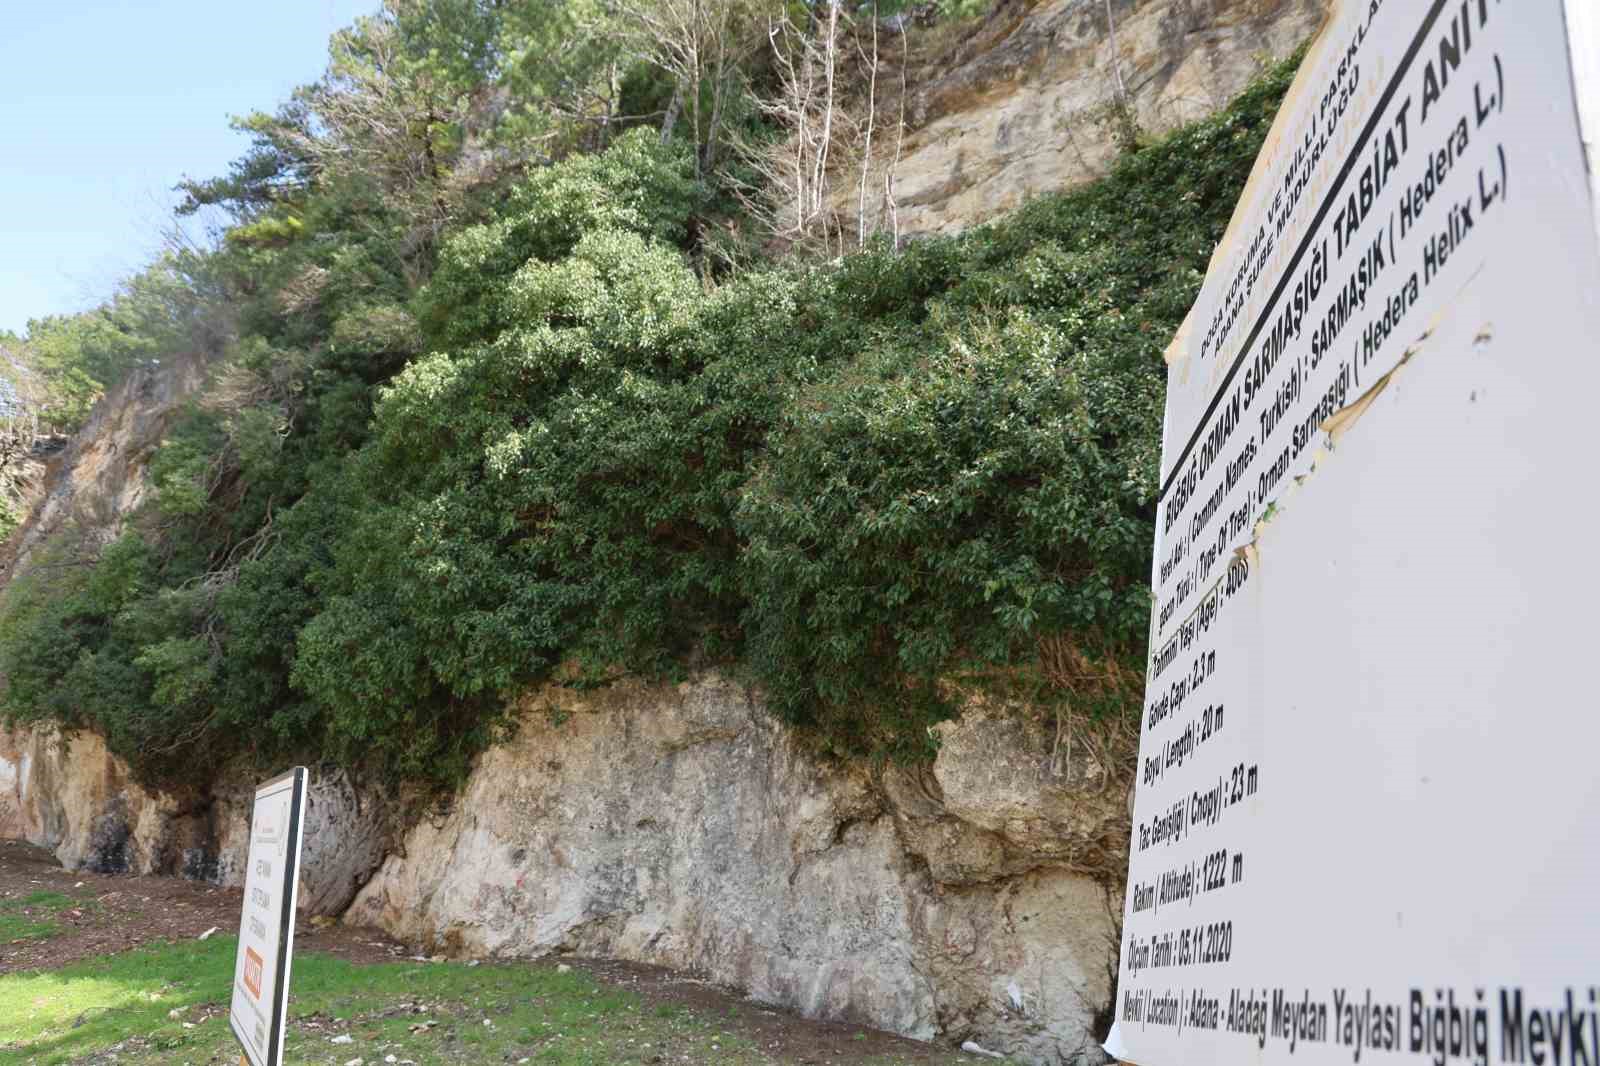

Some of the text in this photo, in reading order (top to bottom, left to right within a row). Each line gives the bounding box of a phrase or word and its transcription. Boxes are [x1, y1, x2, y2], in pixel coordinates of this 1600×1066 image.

[1268, 189, 1281, 224] VE
[1321, 0, 1384, 121] PARKLA
[1192, 480, 1224, 542] Common
[1311, 228, 1385, 371] SARMAŞIK
[1399, 115, 1469, 240] Hedera
[1200, 385, 1241, 480] ORMAN
[1243, 239, 1328, 410] SARMAŞIĞI
[1333, 94, 1411, 260] TABİAT
[1214, 293, 1244, 358] ADANA
[1246, 231, 1274, 297] ŞUBE
[1200, 543, 1217, 583] Type
[1218, 520, 1228, 556] Of
[1258, 446, 1290, 505] Orman
[1363, 272, 1419, 367] Hedera
[1424, 196, 1474, 286] Helix
[1207, 649, 1216, 678] m
[1143, 754, 1161, 788] Boyu
[1201, 704, 1213, 742] 20
[1215, 703, 1224, 733] m
[1138, 823, 1151, 852] Tac
[1230, 762, 1244, 805] 23
[1247, 764, 1258, 796] m
[1132, 880, 1155, 913] Rakım
[1203, 848, 1227, 892] 1222
[1232, 852, 1243, 884] m
[1150, 930, 1173, 969] Tarihi
[1178, 920, 1232, 968] 05.11.2020
[1147, 988, 1178, 1026] Location
[1188, 987, 1219, 1029] Adana
[1226, 988, 1268, 1049] Aladağ
[1271, 988, 1327, 1054] Meydan
[1333, 988, 1401, 1063] Yaylası
[1409, 988, 1489, 1066] Bığbığ
[1499, 986, 1600, 1066] Mevki
